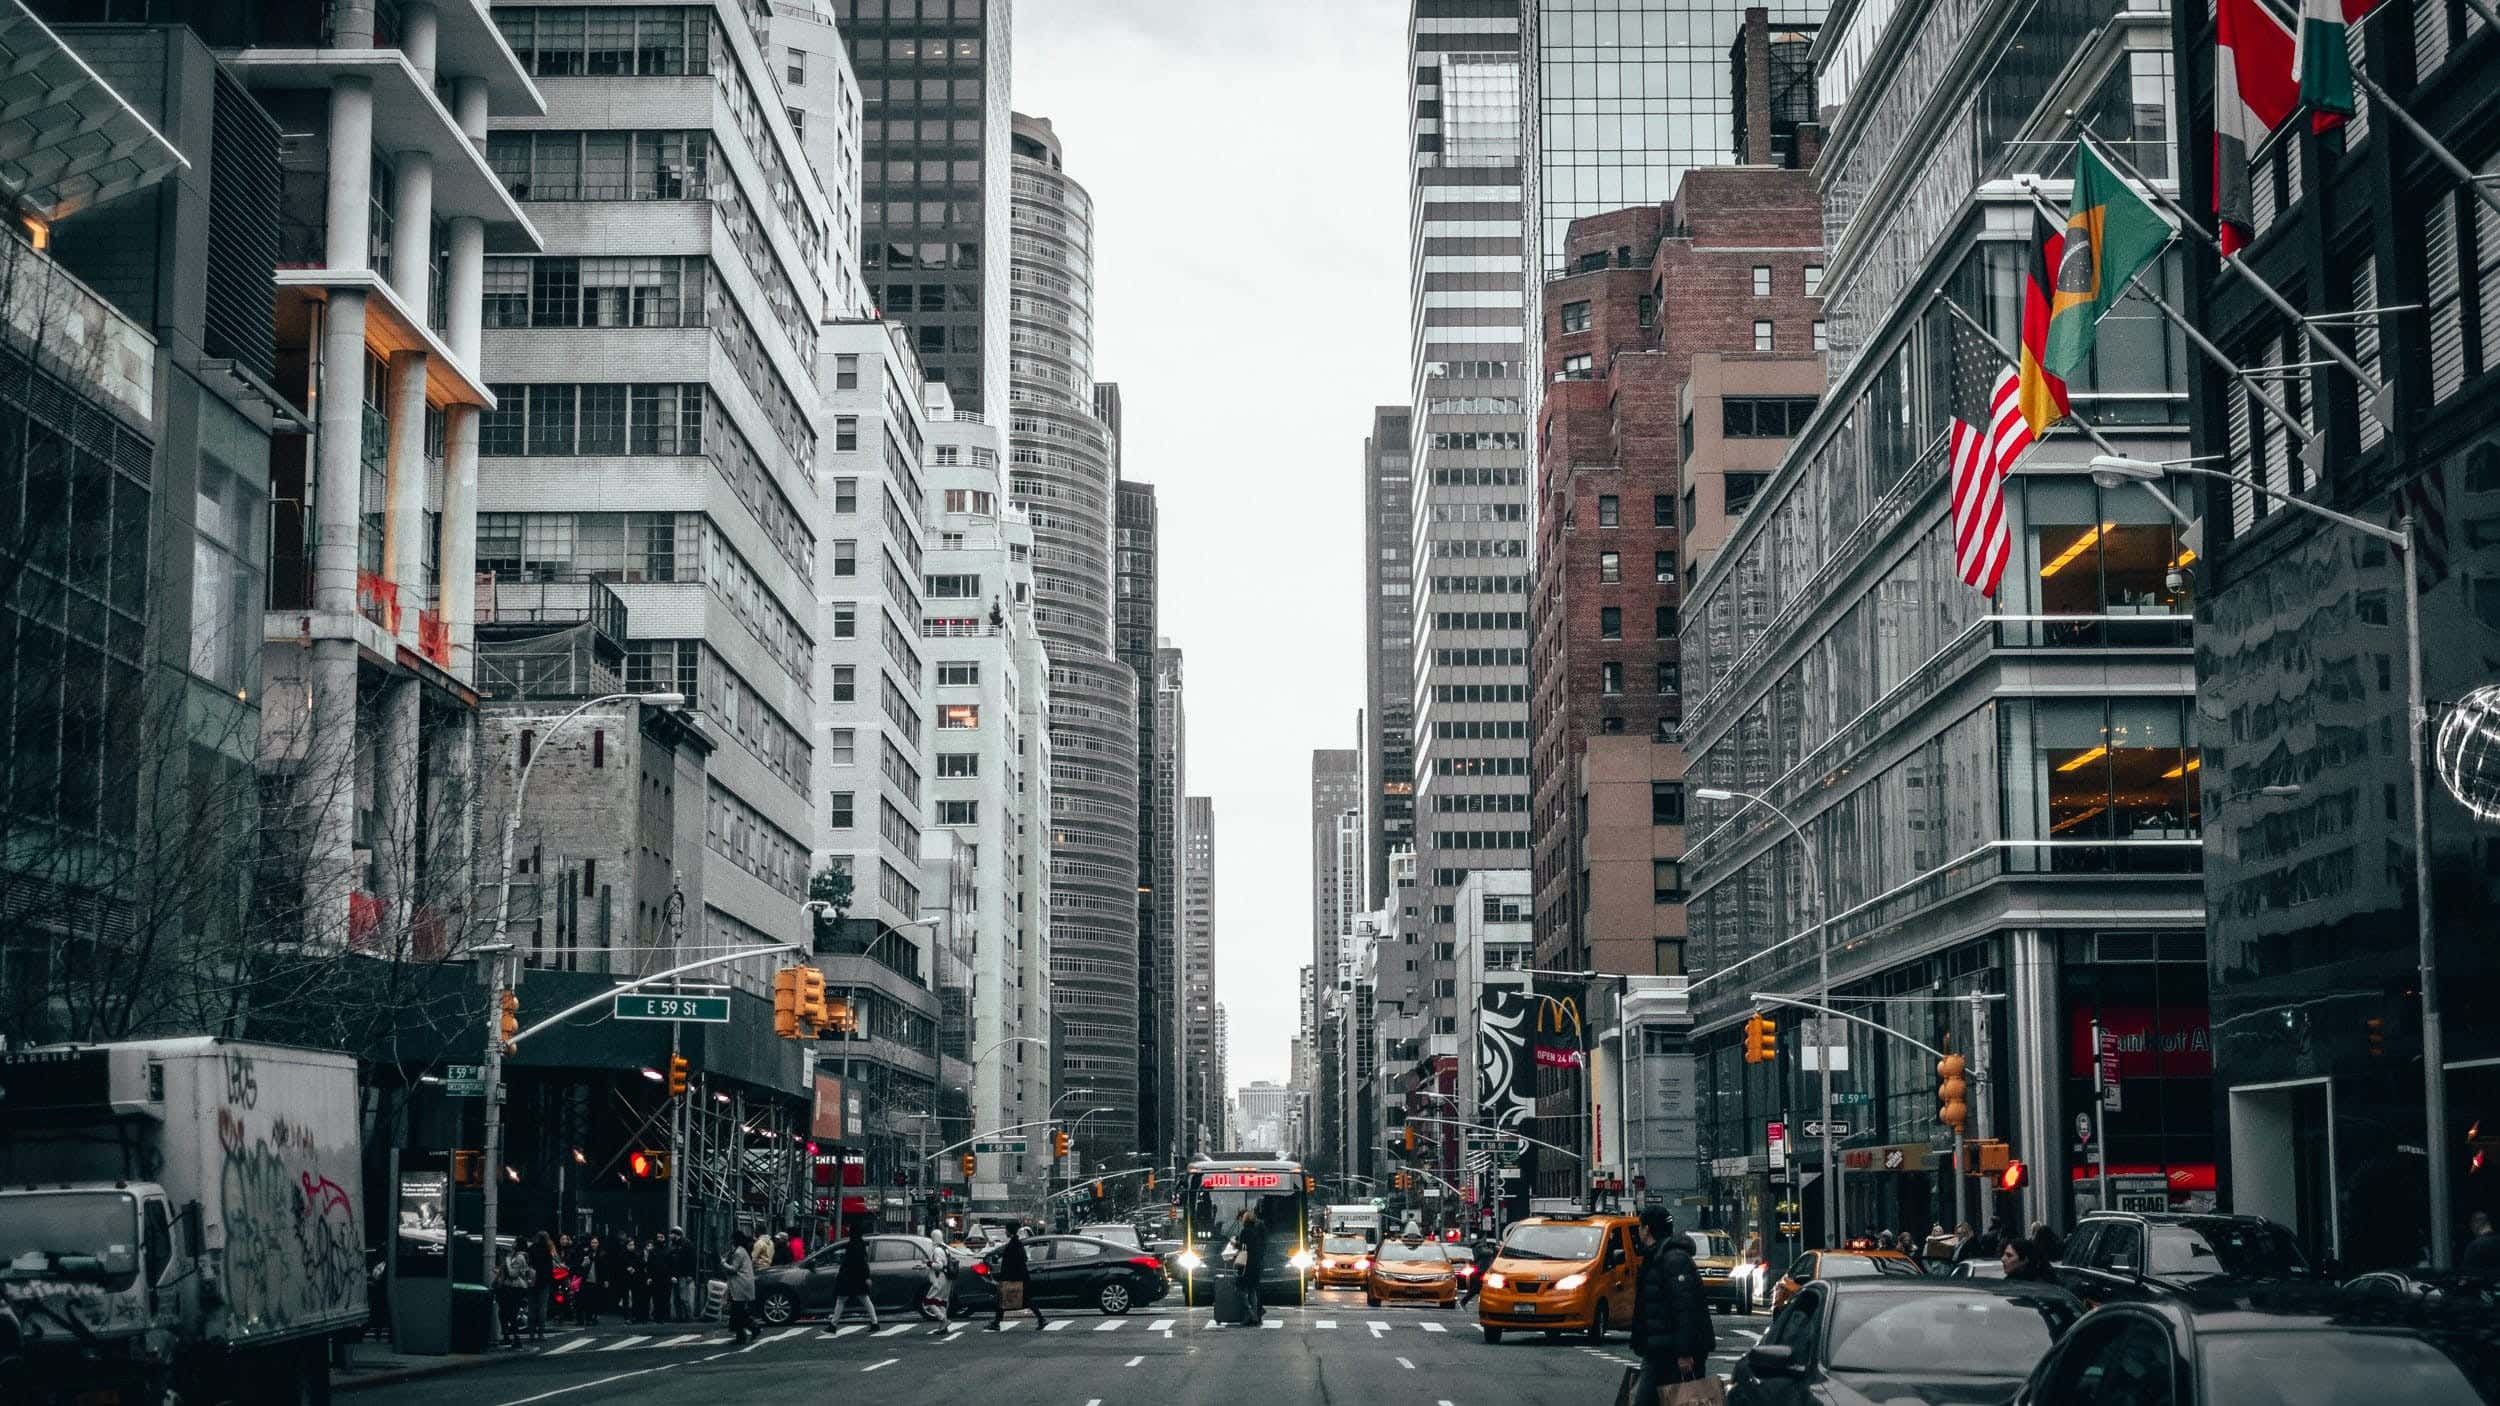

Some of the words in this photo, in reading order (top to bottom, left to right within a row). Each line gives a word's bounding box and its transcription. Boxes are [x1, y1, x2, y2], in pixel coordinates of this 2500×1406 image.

[647, 1000, 656, 1014] E
[661, 1000, 678, 1015] 59
[683, 1001, 697, 1016] St
[1537, 1050, 1556, 1062] OPEN
[1557, 1054, 1567, 1063] 24
[448, 1067, 455, 1079] E
[456, 1067, 467, 1079] 59
[1839, 1093, 1845, 1104] E
[1848, 1094, 1859, 1104] 59
